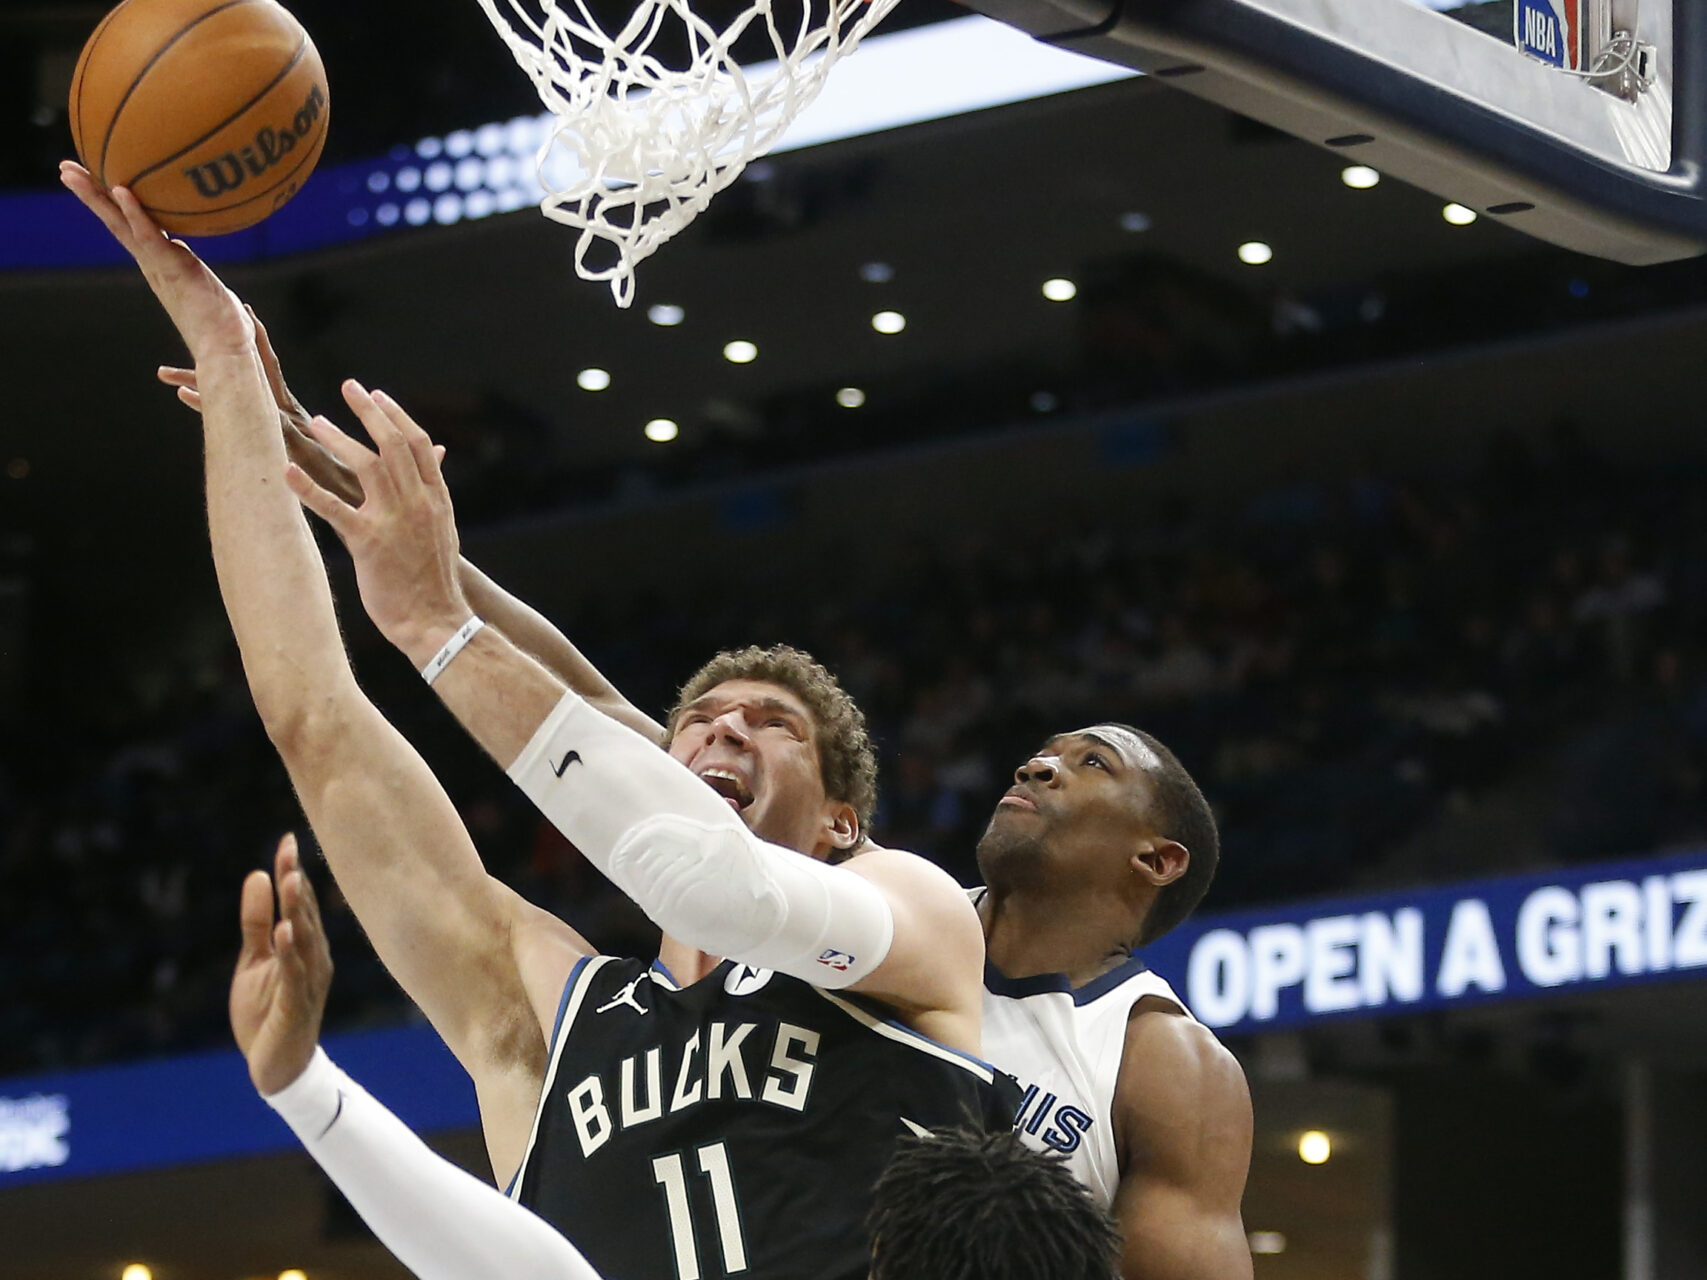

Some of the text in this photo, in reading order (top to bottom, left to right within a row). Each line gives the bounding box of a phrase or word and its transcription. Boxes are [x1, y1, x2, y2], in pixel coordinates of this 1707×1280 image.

[1525, 6, 1556, 57] NBA
[184, 84, 324, 197] Wilson
[1187, 870, 1707, 1028] OPEN A GRIZ
[567, 1021, 821, 1159] BUCKS
